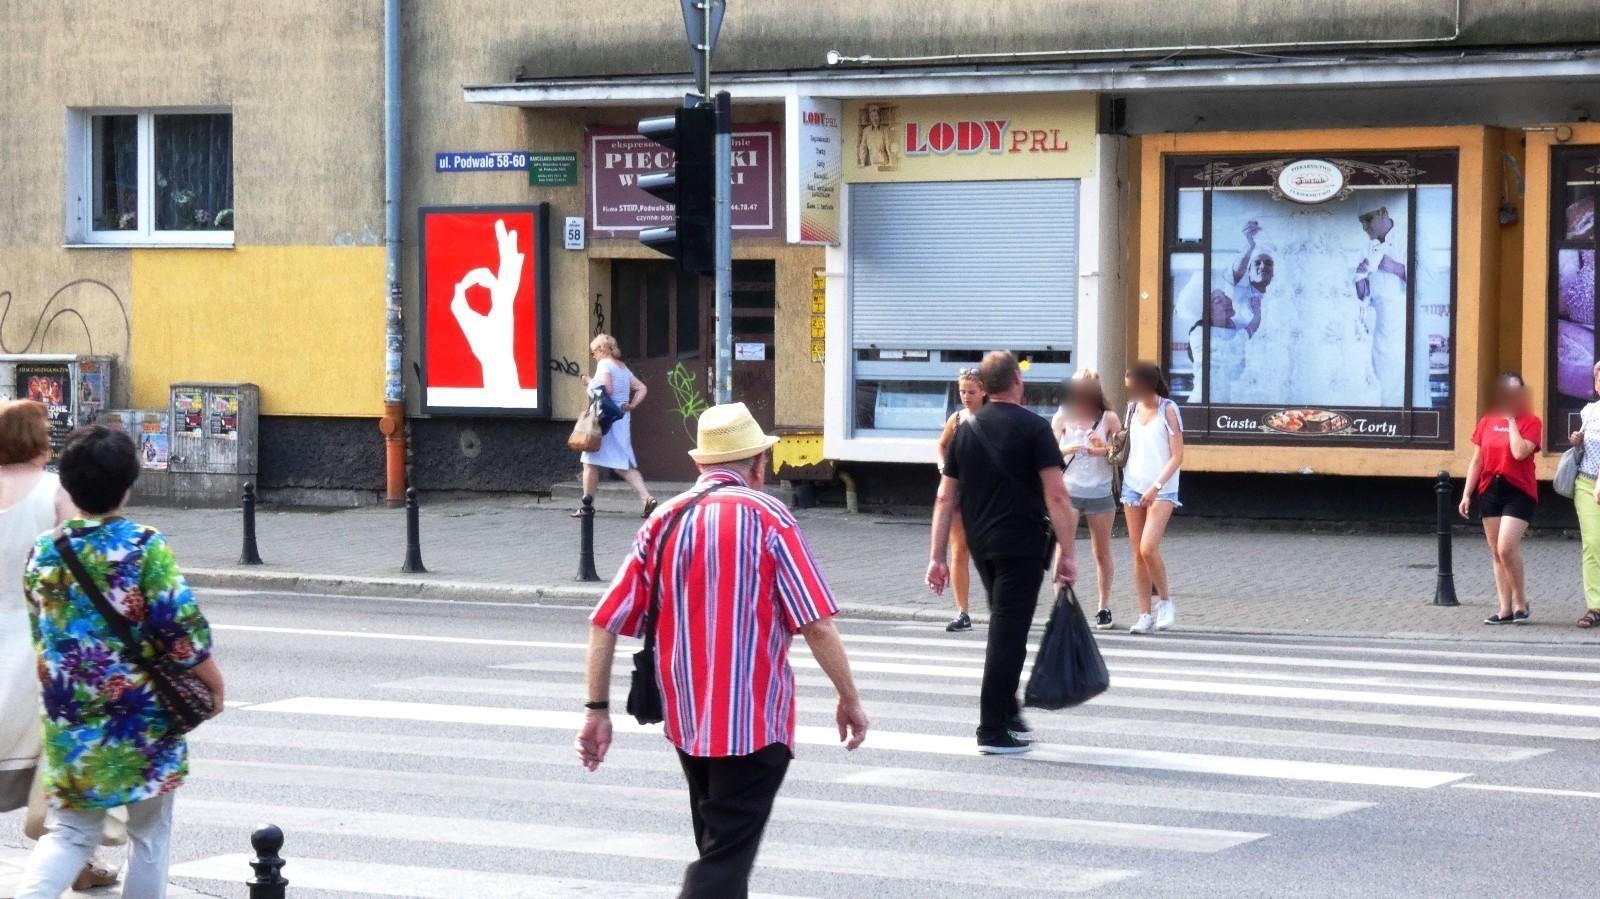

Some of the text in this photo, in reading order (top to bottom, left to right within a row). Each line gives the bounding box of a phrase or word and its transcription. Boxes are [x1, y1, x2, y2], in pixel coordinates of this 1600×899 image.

[802, 111, 826, 127] LODY
[612, 140, 662, 150] ekspresow
[905, 120, 1069, 156] LODY PRL
[439, 154, 526, 168] ul. Podwale 58-60
[568, 229, 581, 241] 58
[1216, 415, 1397, 437] Ciasta Torty
